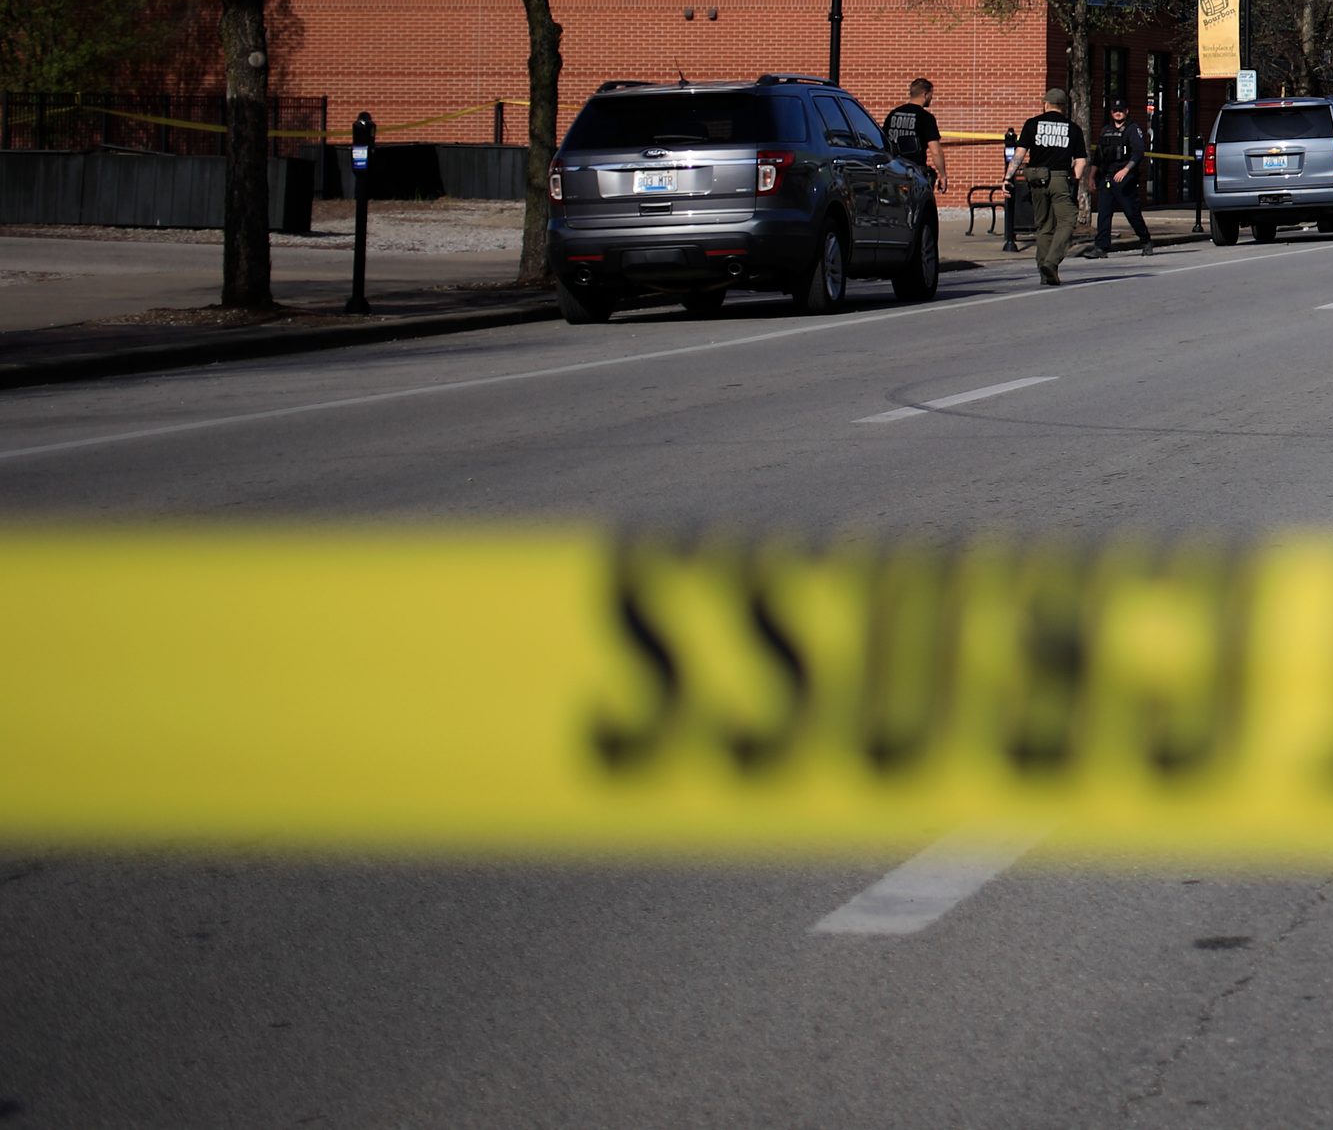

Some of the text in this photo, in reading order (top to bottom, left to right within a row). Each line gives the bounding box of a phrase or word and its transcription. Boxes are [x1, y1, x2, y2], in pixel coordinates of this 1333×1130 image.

[1203, 8, 1236, 26] Bourbon
[890, 115, 917, 130] BOMB
[1037, 124, 1069, 136] BOMB
[1034, 134, 1070, 148] SQUAD
[590, 532, 1245, 775] CROSS
